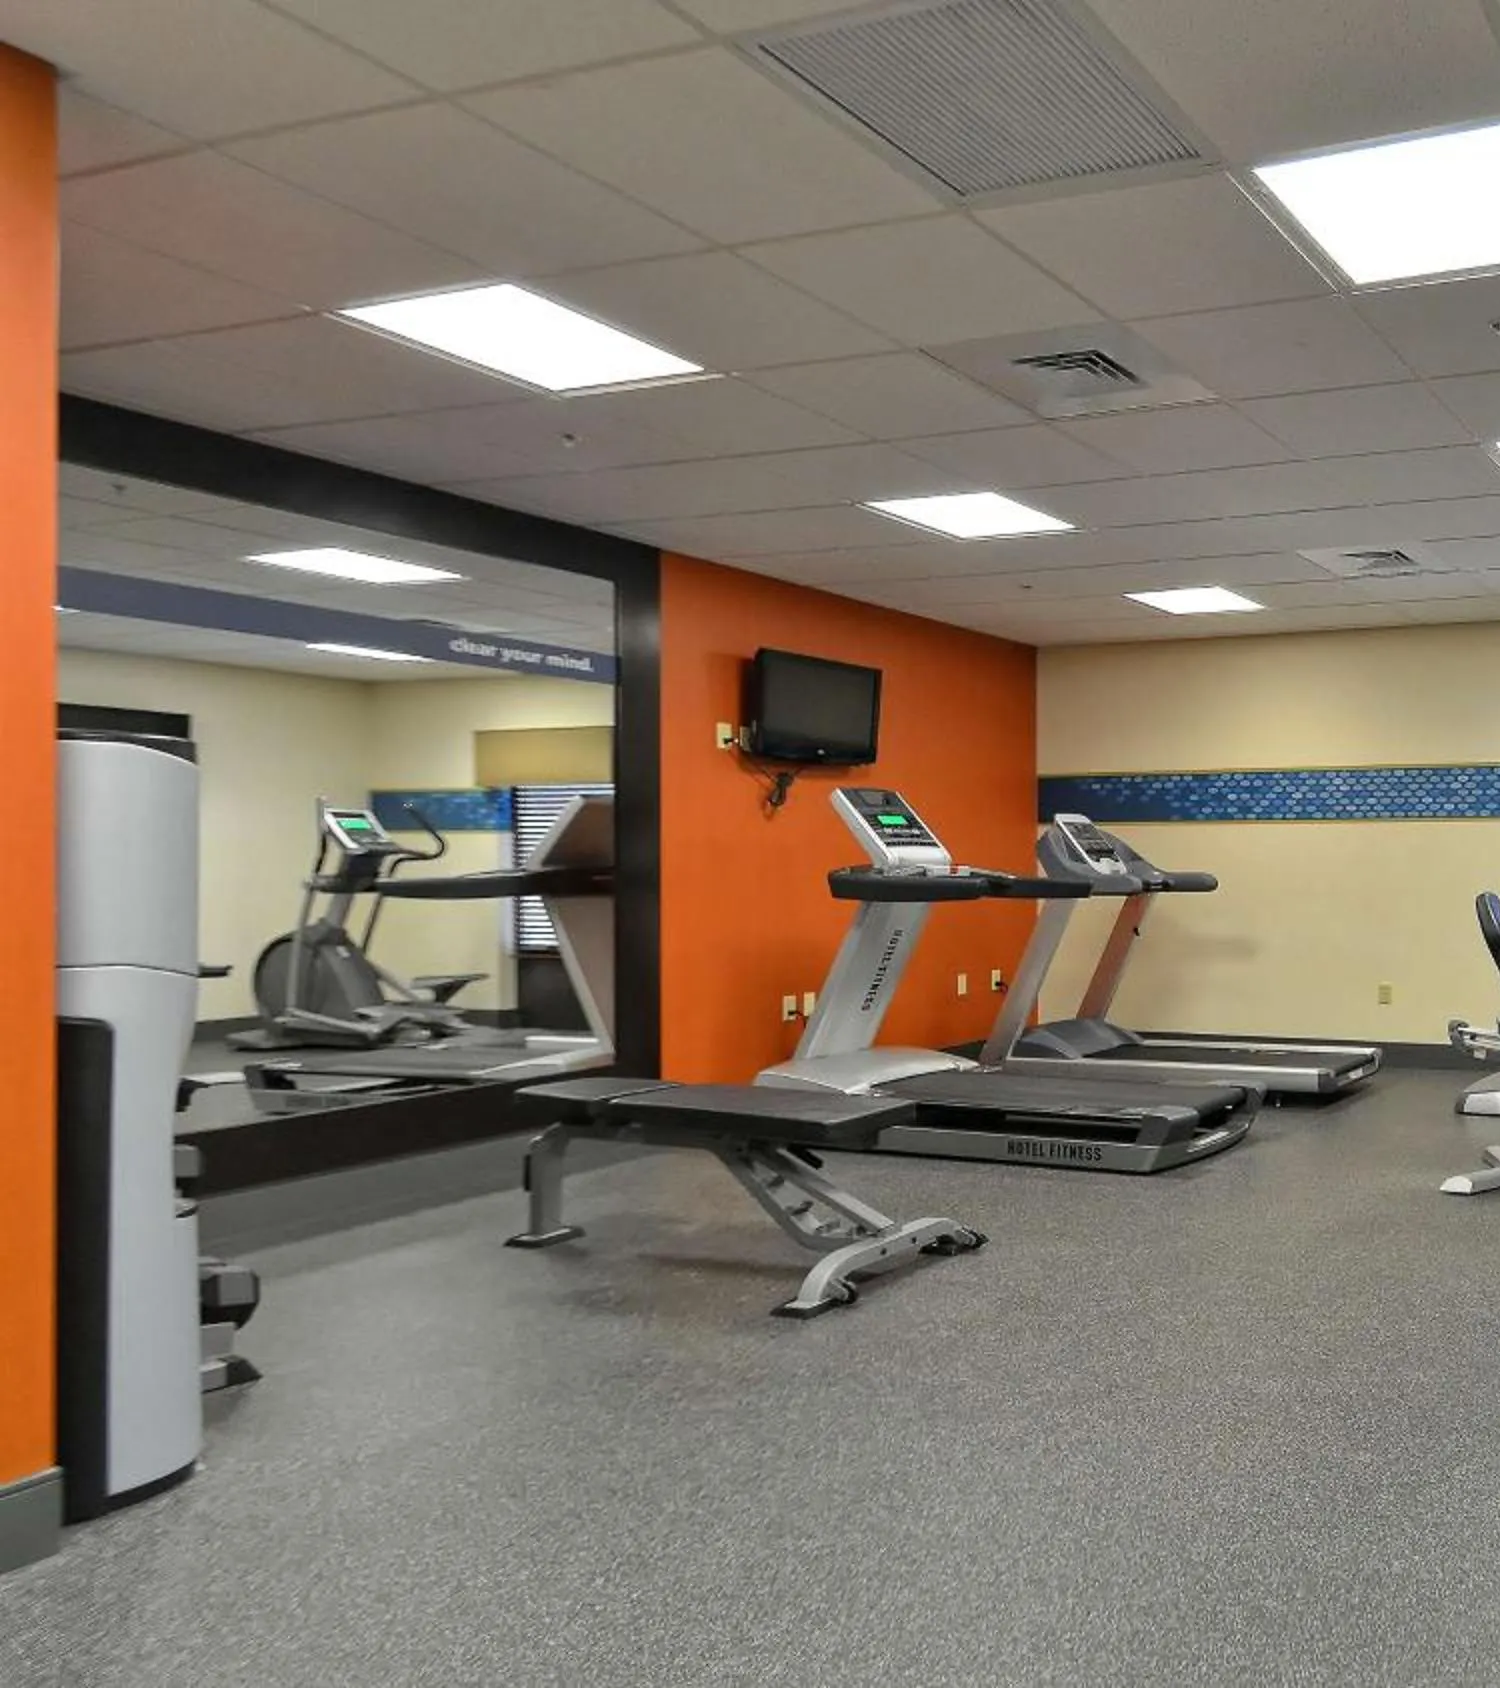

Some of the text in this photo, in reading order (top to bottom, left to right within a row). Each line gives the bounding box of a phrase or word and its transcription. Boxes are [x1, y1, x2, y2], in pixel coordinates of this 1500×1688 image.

[449, 637, 595, 673] clear your mind.
[881, 929, 904, 964] HOTEL
[1007, 1140, 1102, 1162] HOTEL FITNESS
